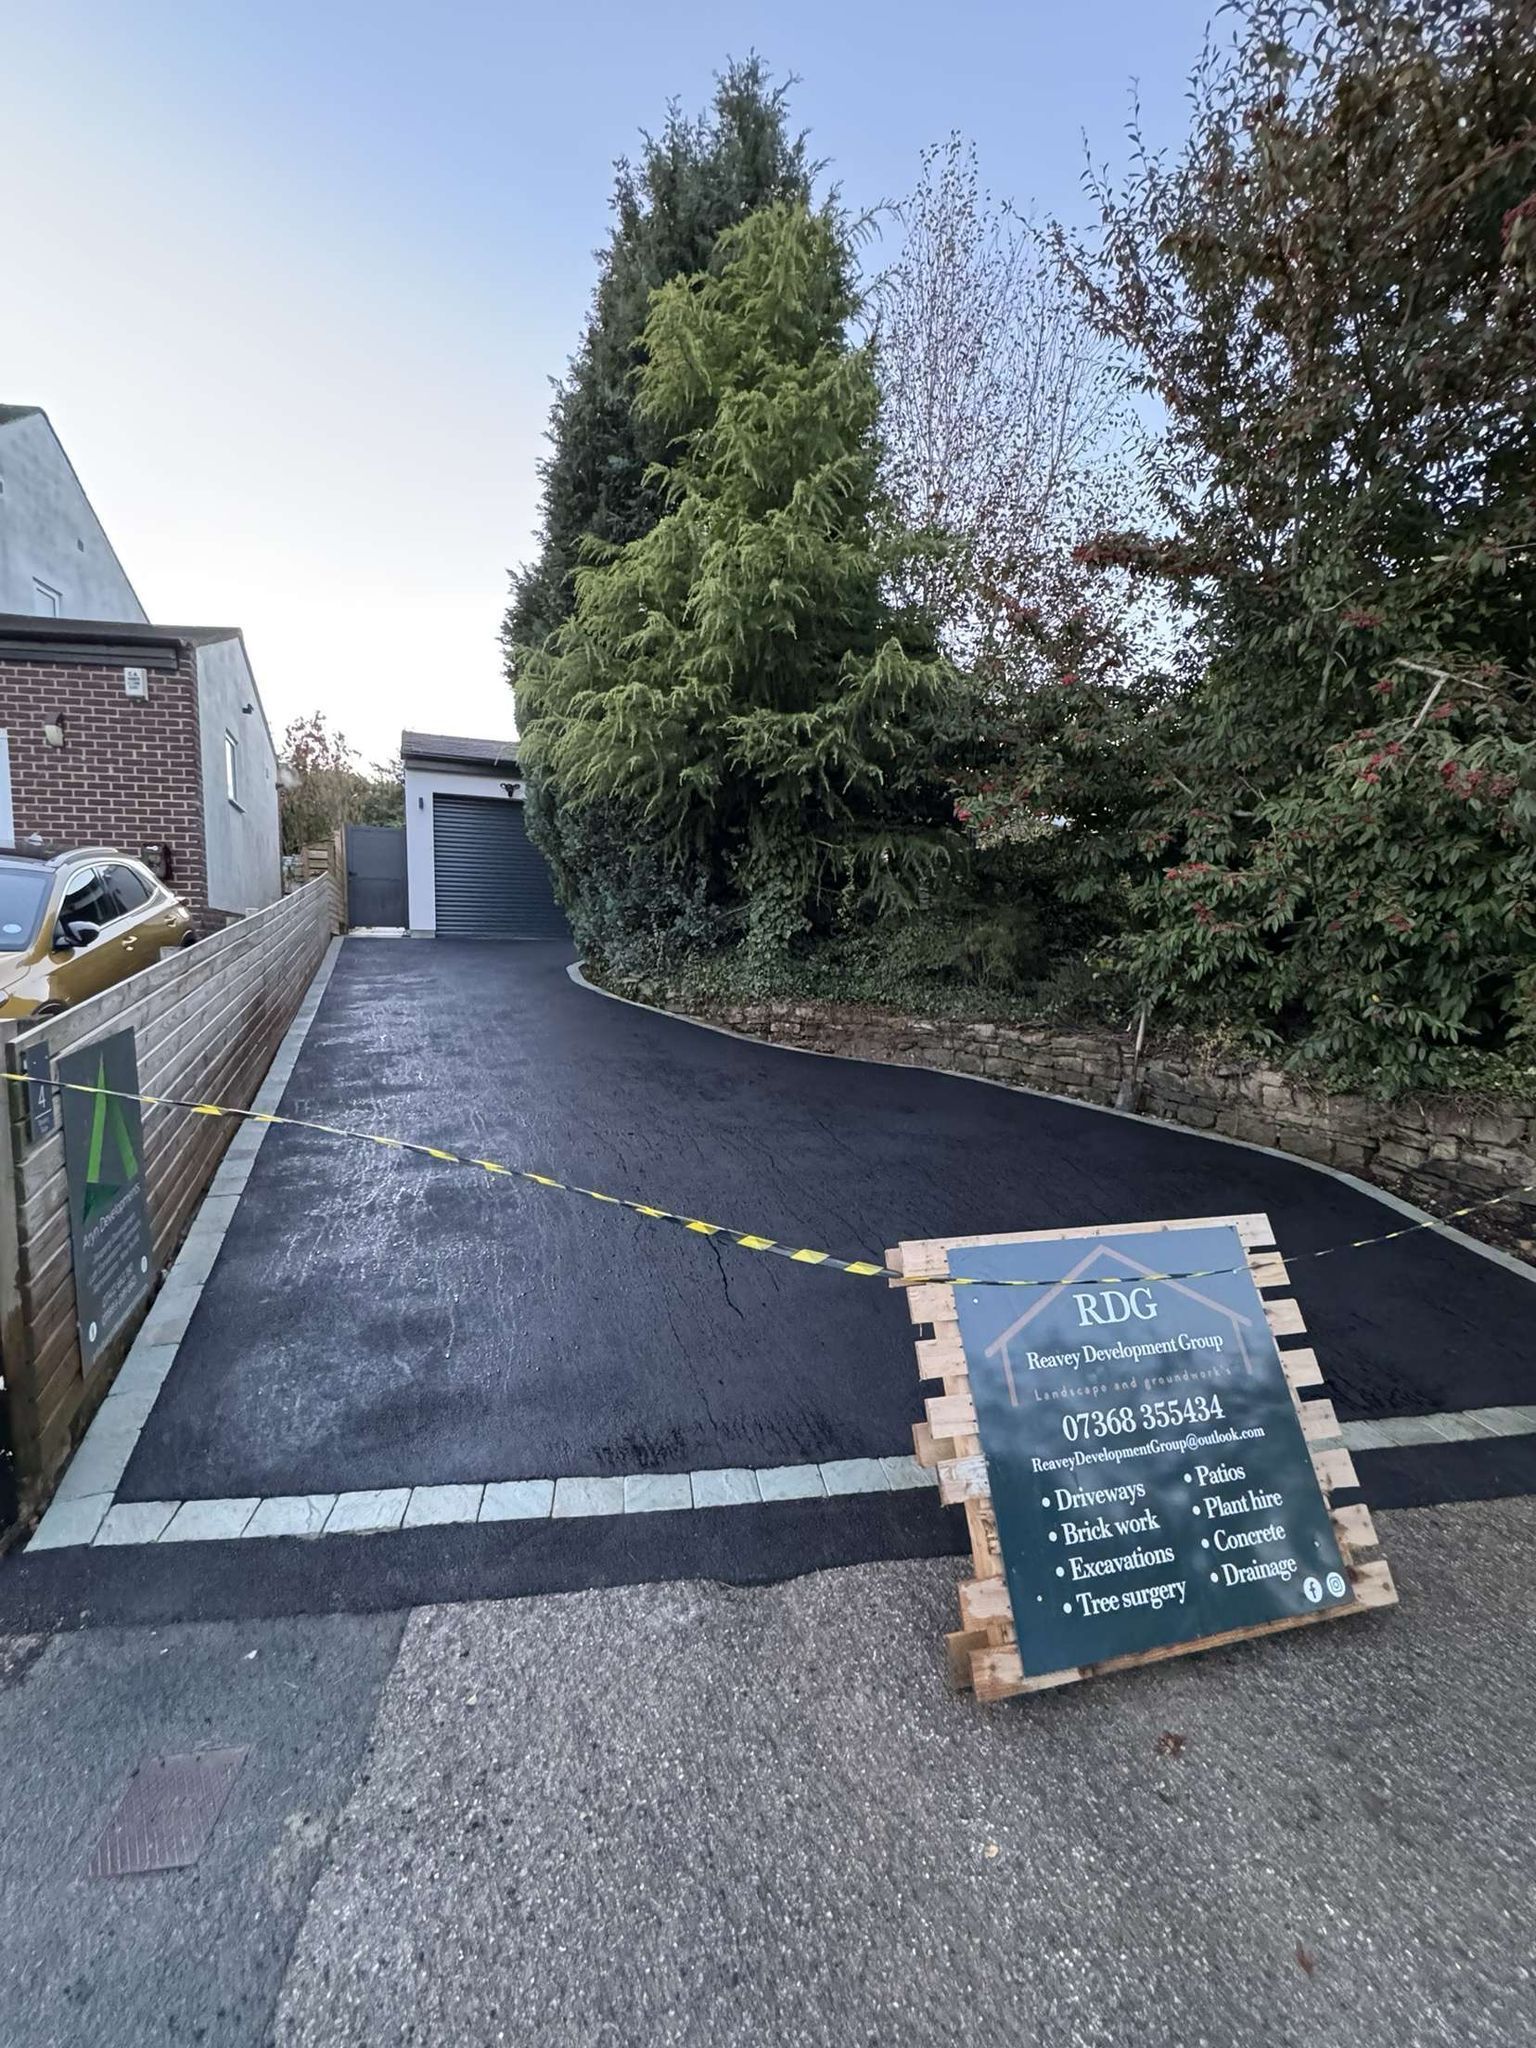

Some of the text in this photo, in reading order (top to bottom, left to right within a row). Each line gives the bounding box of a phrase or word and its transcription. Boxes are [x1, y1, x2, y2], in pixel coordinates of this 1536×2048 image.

[1073, 1287, 1158, 1326] RDG
[1026, 1333, 1223, 1370] Reavey Development Group
[1034, 1383, 1107, 1401] Landscape
[1114, 1376, 1138, 1391] and
[1062, 1394, 1226, 1442] 07368 355434
[1032, 1425, 1265, 1473] ReaveyDevelopmentGroup@outlook.com
[1195, 1463, 1246, 1487] Patios
[1054, 1483, 1146, 1511] Driveways
[1203, 1489, 1283, 1519] Plant hire
[1061, 1508, 1161, 1545] Brick work
[1214, 1524, 1286, 1552] Concrete
[1068, 1546, 1175, 1581] Excavations
[1221, 1558, 1298, 1587] Drainage
[1076, 1581, 1187, 1617] Tree surgery
